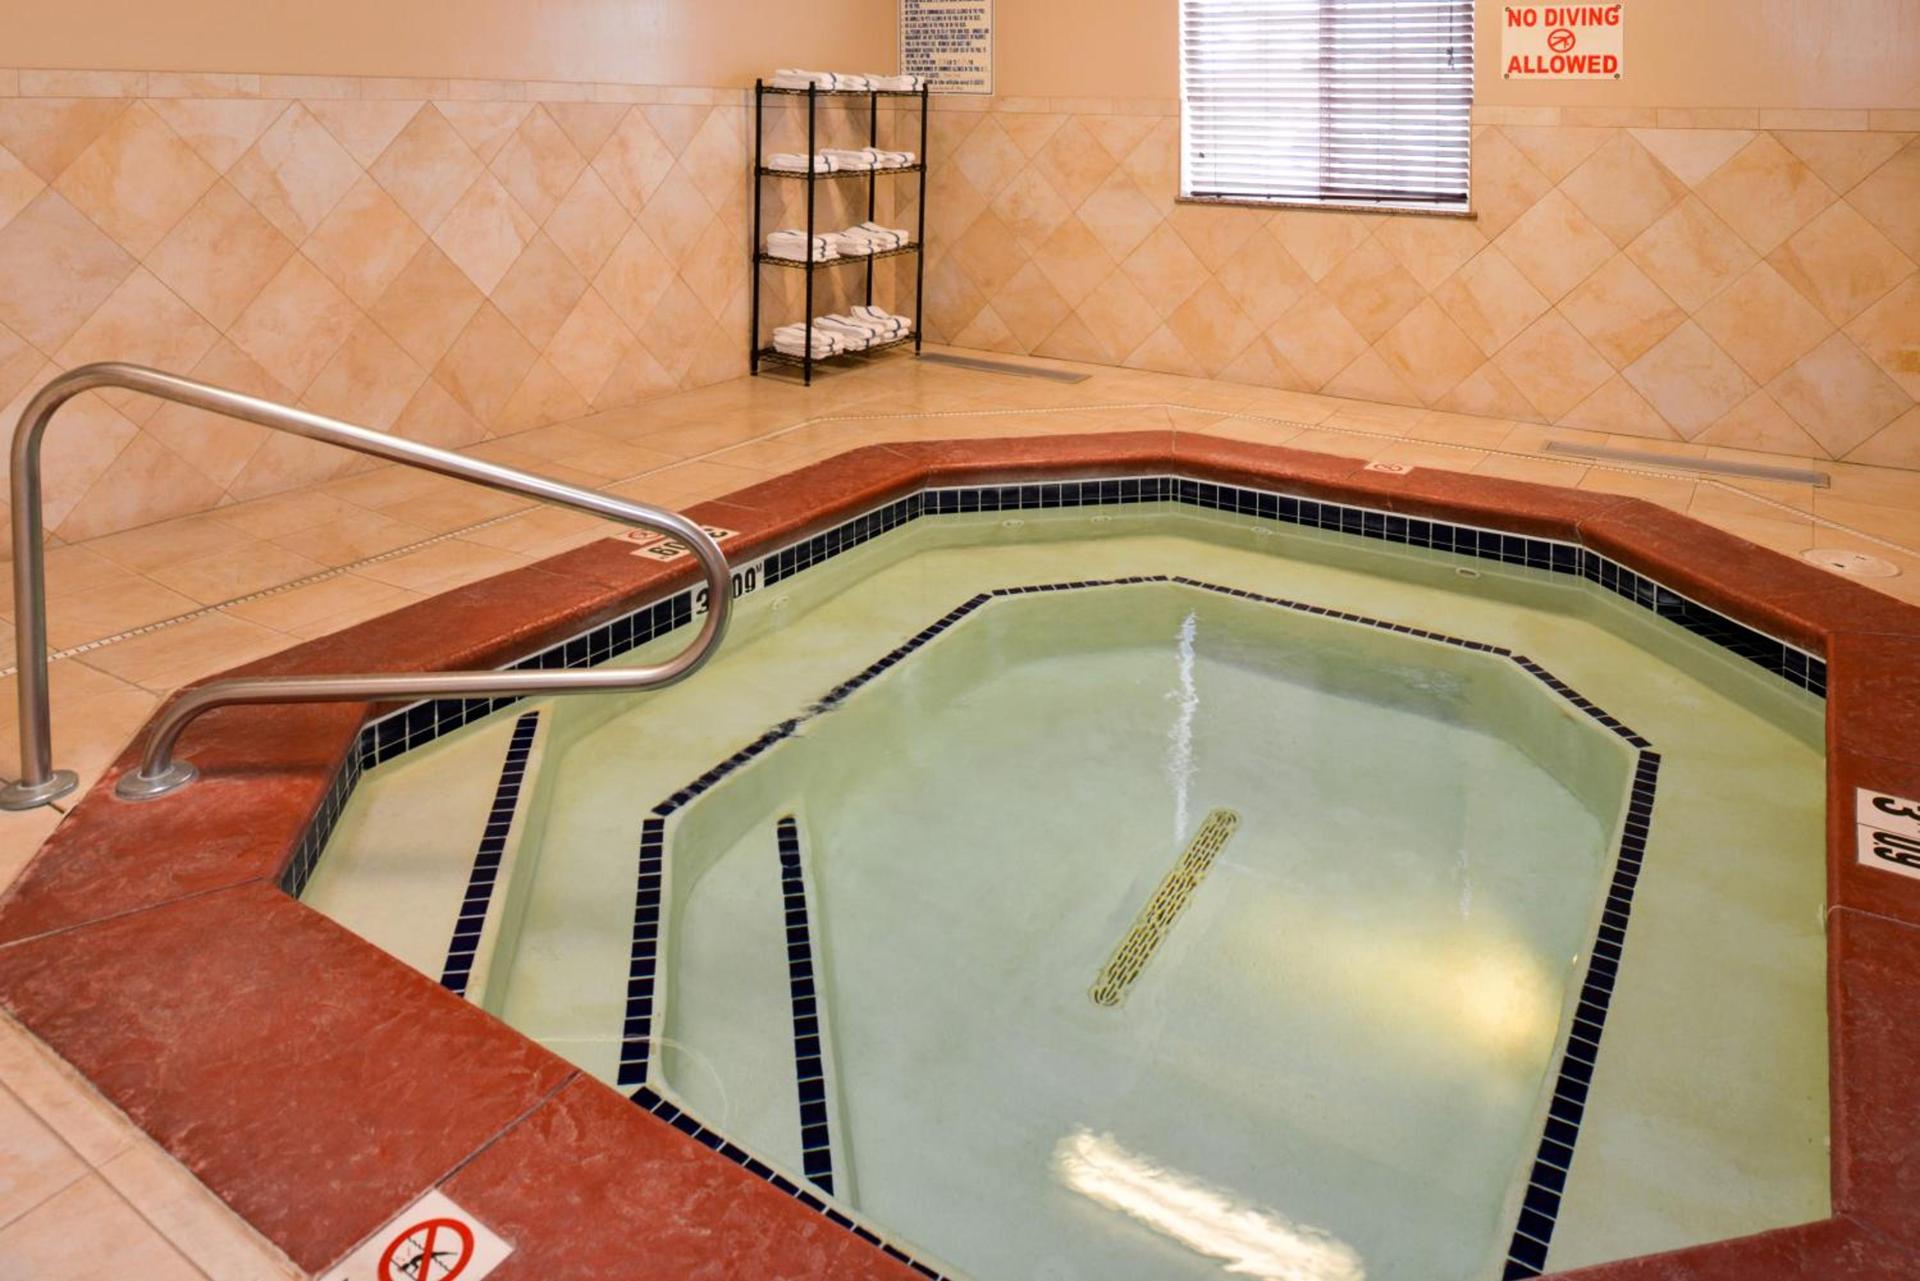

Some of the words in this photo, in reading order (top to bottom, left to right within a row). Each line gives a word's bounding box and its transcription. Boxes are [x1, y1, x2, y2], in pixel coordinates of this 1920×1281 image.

[1507, 8, 1537, 27] NO
[1544, 6, 1620, 26] DIVING
[1507, 54, 1618, 73] ALLOWED
